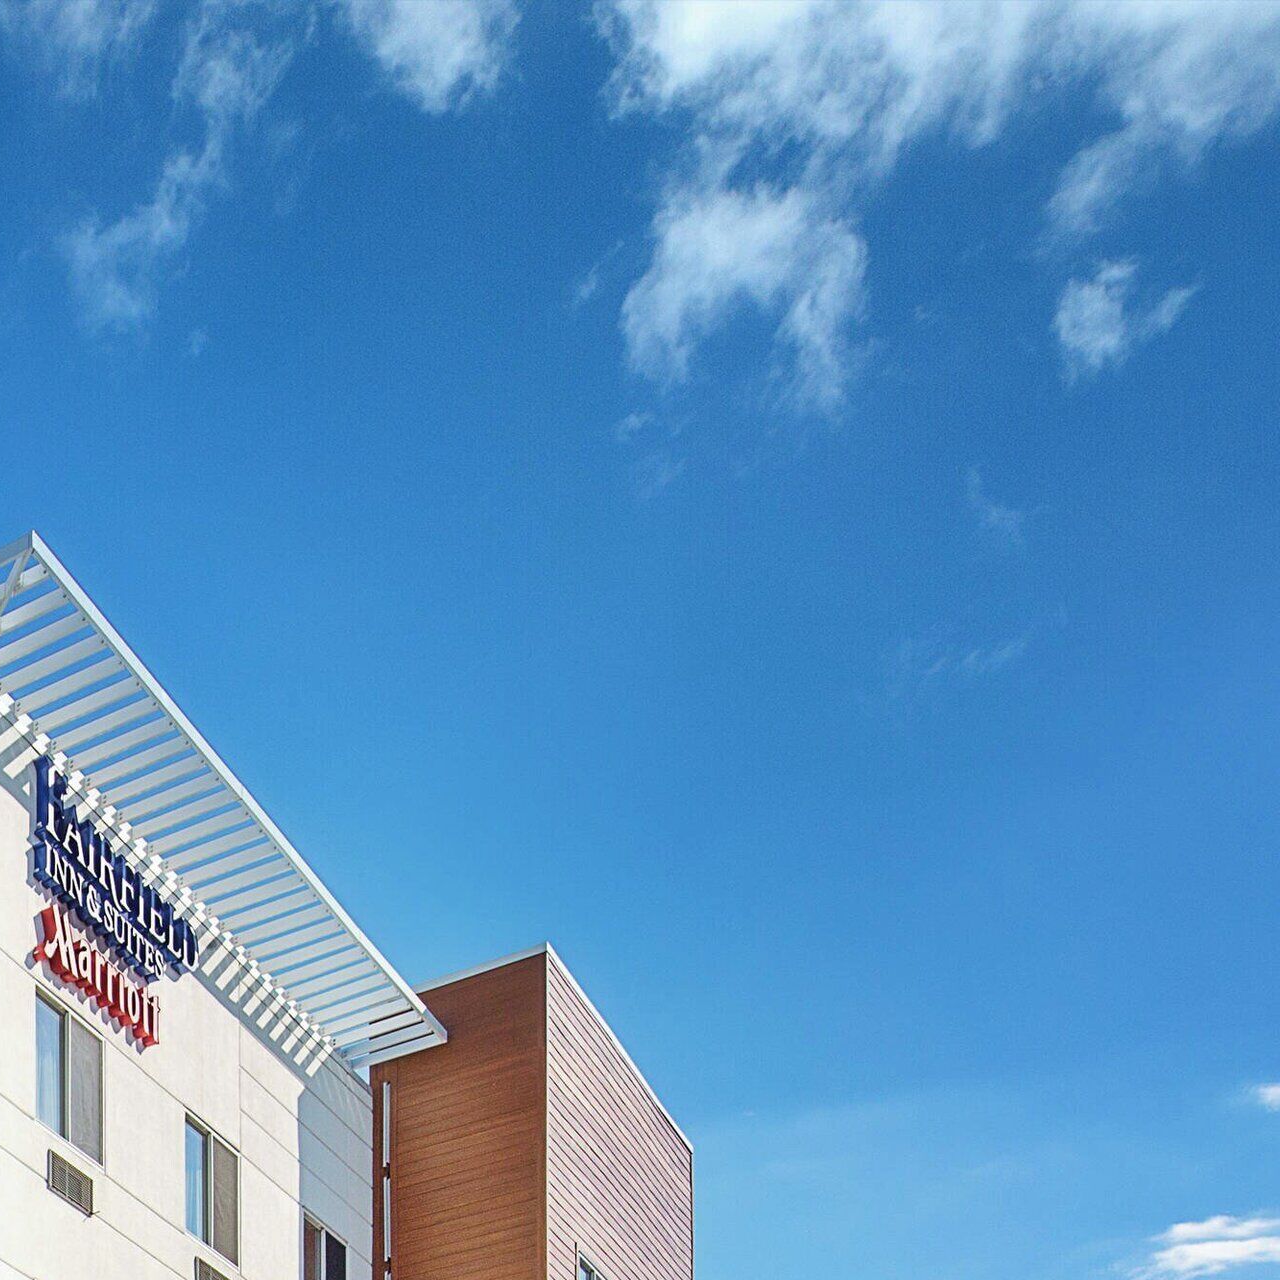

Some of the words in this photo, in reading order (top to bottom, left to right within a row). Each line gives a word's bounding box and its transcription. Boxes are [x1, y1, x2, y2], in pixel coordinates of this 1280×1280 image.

[36, 756, 200, 972] FAIRFIELD
[38, 839, 84, 908] INN
[86, 884, 104, 923] &
[103, 899, 165, 981] SUITES
[38, 903, 161, 1046] Marriott
